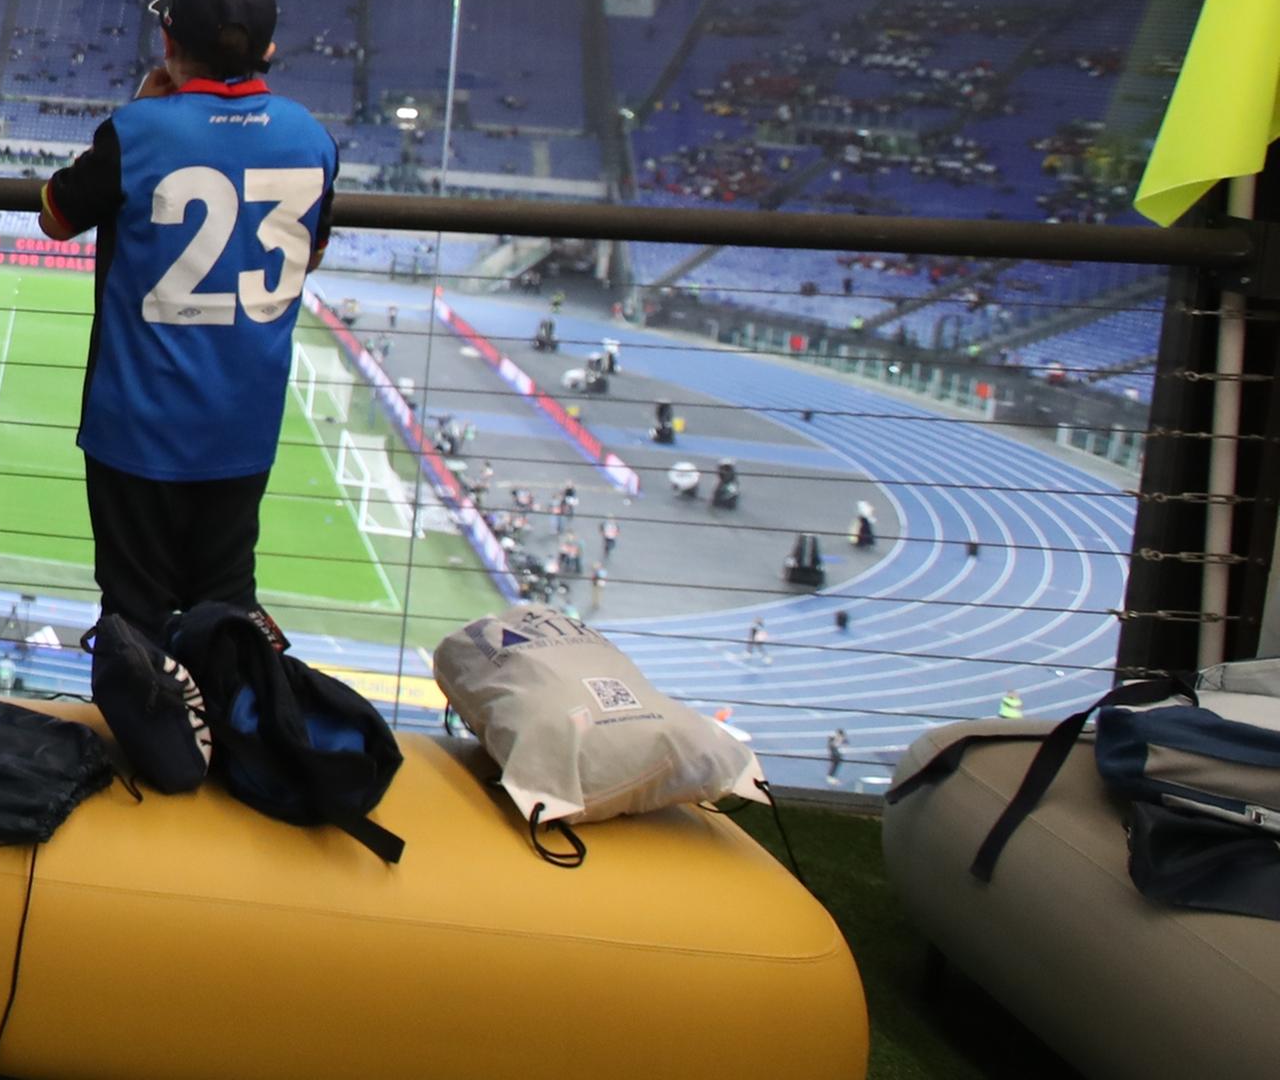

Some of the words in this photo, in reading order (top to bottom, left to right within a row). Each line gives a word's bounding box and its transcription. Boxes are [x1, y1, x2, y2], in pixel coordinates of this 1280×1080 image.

[15, 238, 80, 254] CRAFTED
[142, 166, 325, 325] 23
[9, 253, 39, 267] FOR
